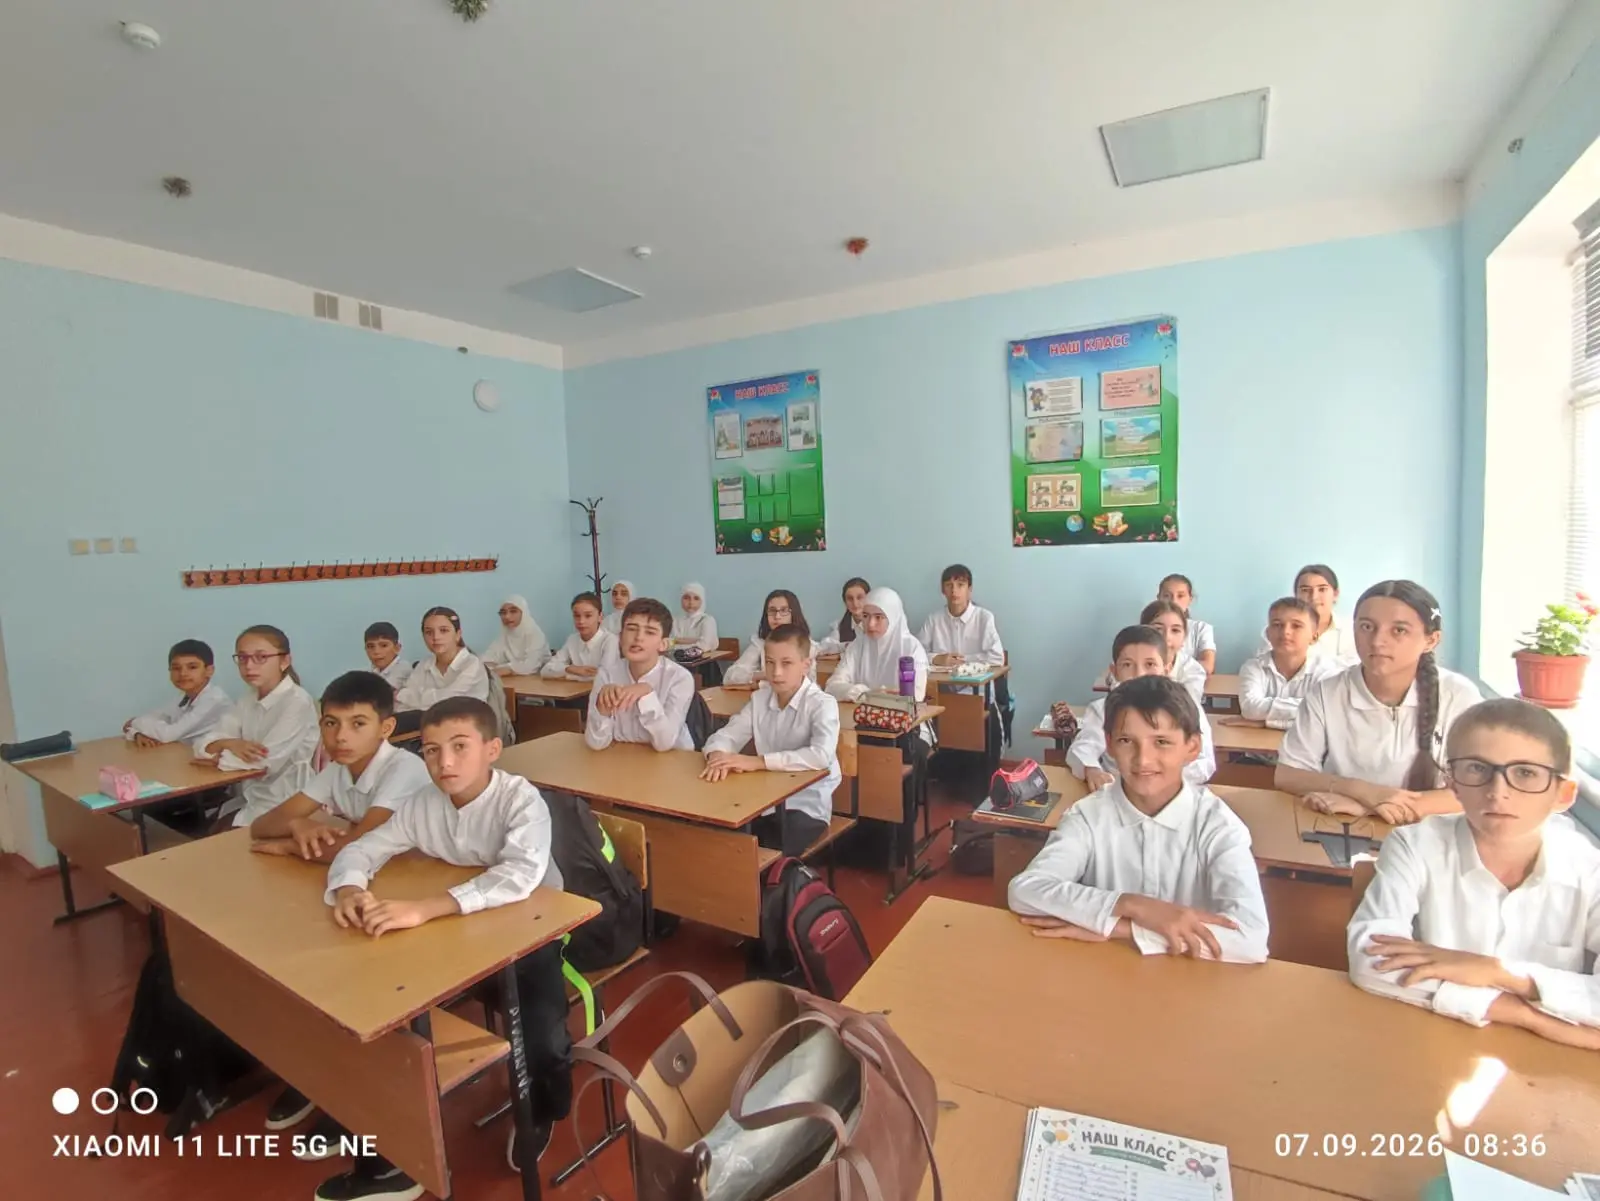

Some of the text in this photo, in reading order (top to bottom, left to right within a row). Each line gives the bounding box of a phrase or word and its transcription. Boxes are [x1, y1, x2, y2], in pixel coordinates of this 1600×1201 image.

[1049, 333, 1130, 357] НАШ КЛАСС
[1081, 1131, 1118, 1146] НАШ
[1124, 1137, 1177, 1162] КЛАСС
